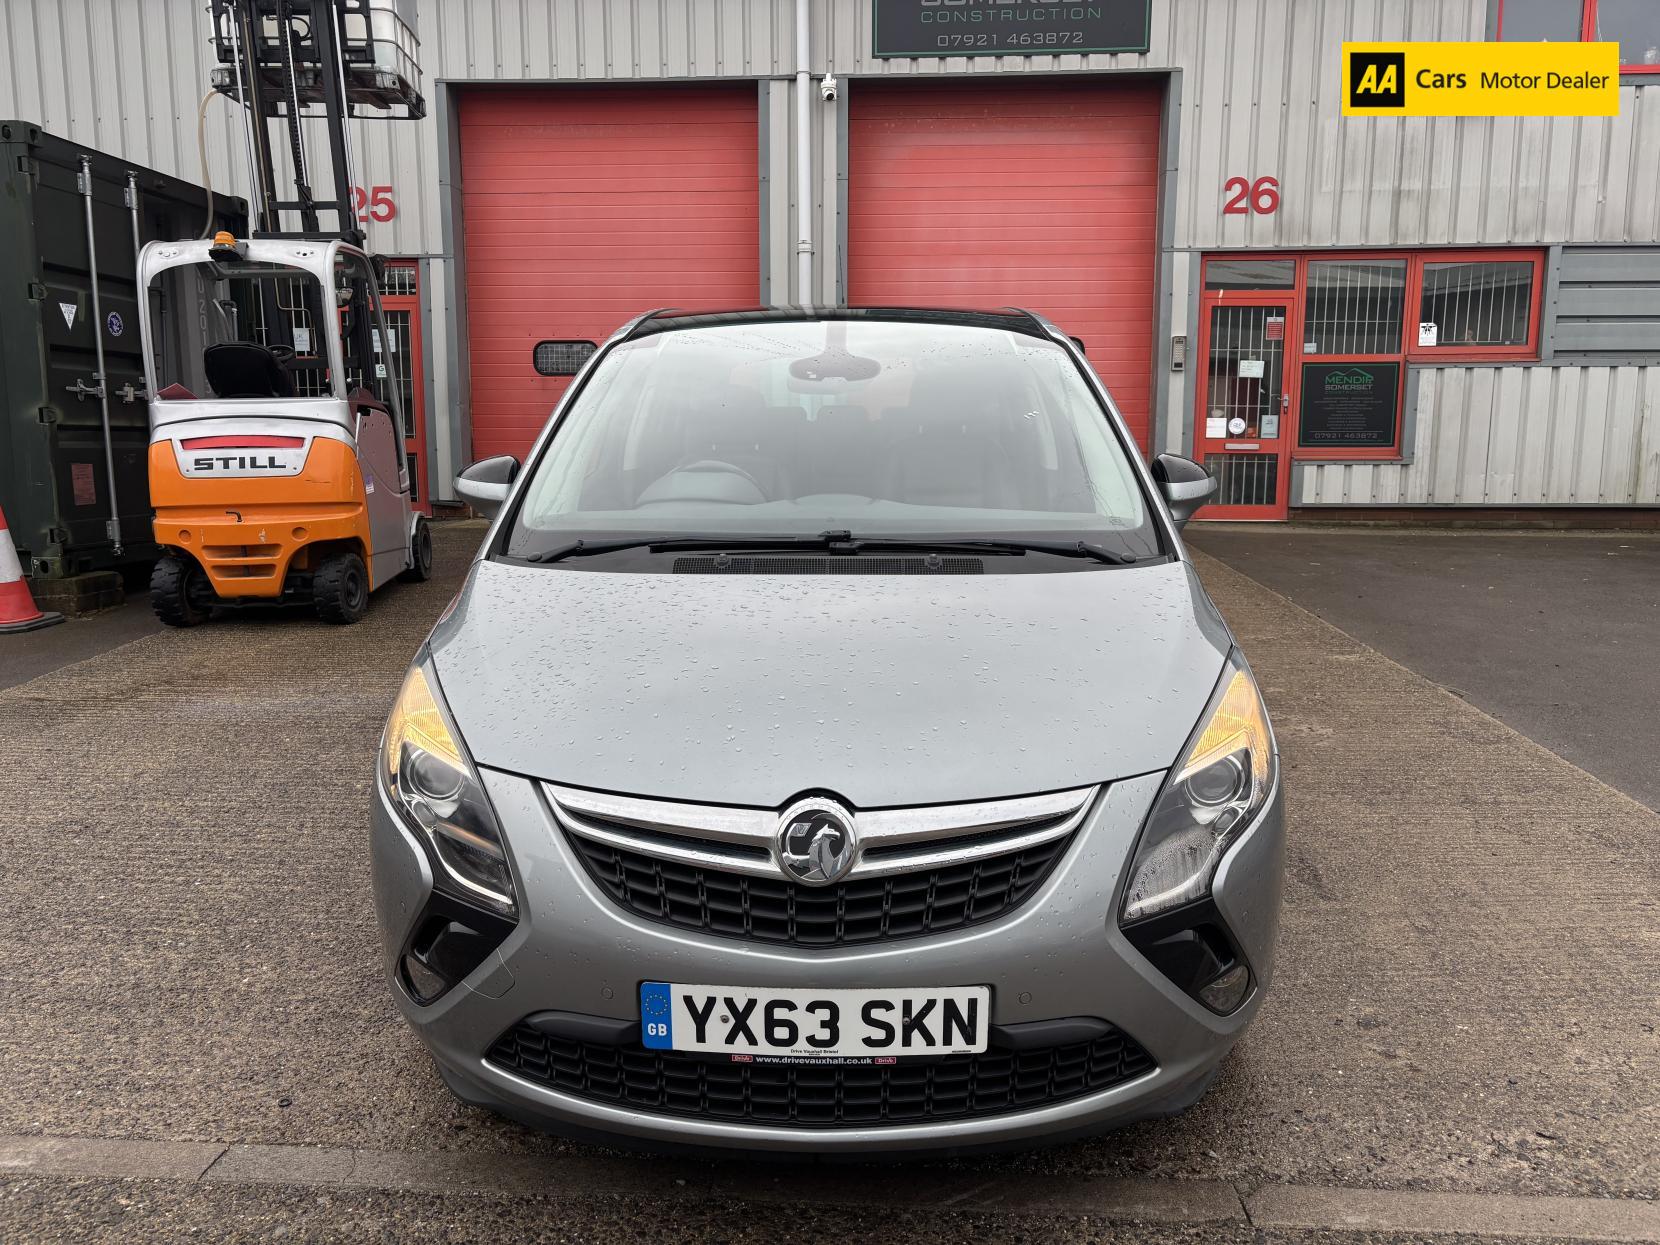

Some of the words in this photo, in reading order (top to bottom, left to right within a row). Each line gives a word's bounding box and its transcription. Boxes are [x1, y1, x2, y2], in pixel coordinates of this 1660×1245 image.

[920, 7, 1102, 23] CONSTRUCTION
[937, 34, 998, 47] 07921
[1006, 31, 1084, 46] 463872
[1223, 176, 1280, 215] 26
[349, 186, 397, 223] 25
[193, 456, 287, 471] STILL
[647, 1022, 667, 1036] GB
[682, 994, 840, 1048] YX63
[861, 997, 978, 1048] SKN
[755, 1056, 872, 1065] www.drivevauxhall.co.uk
